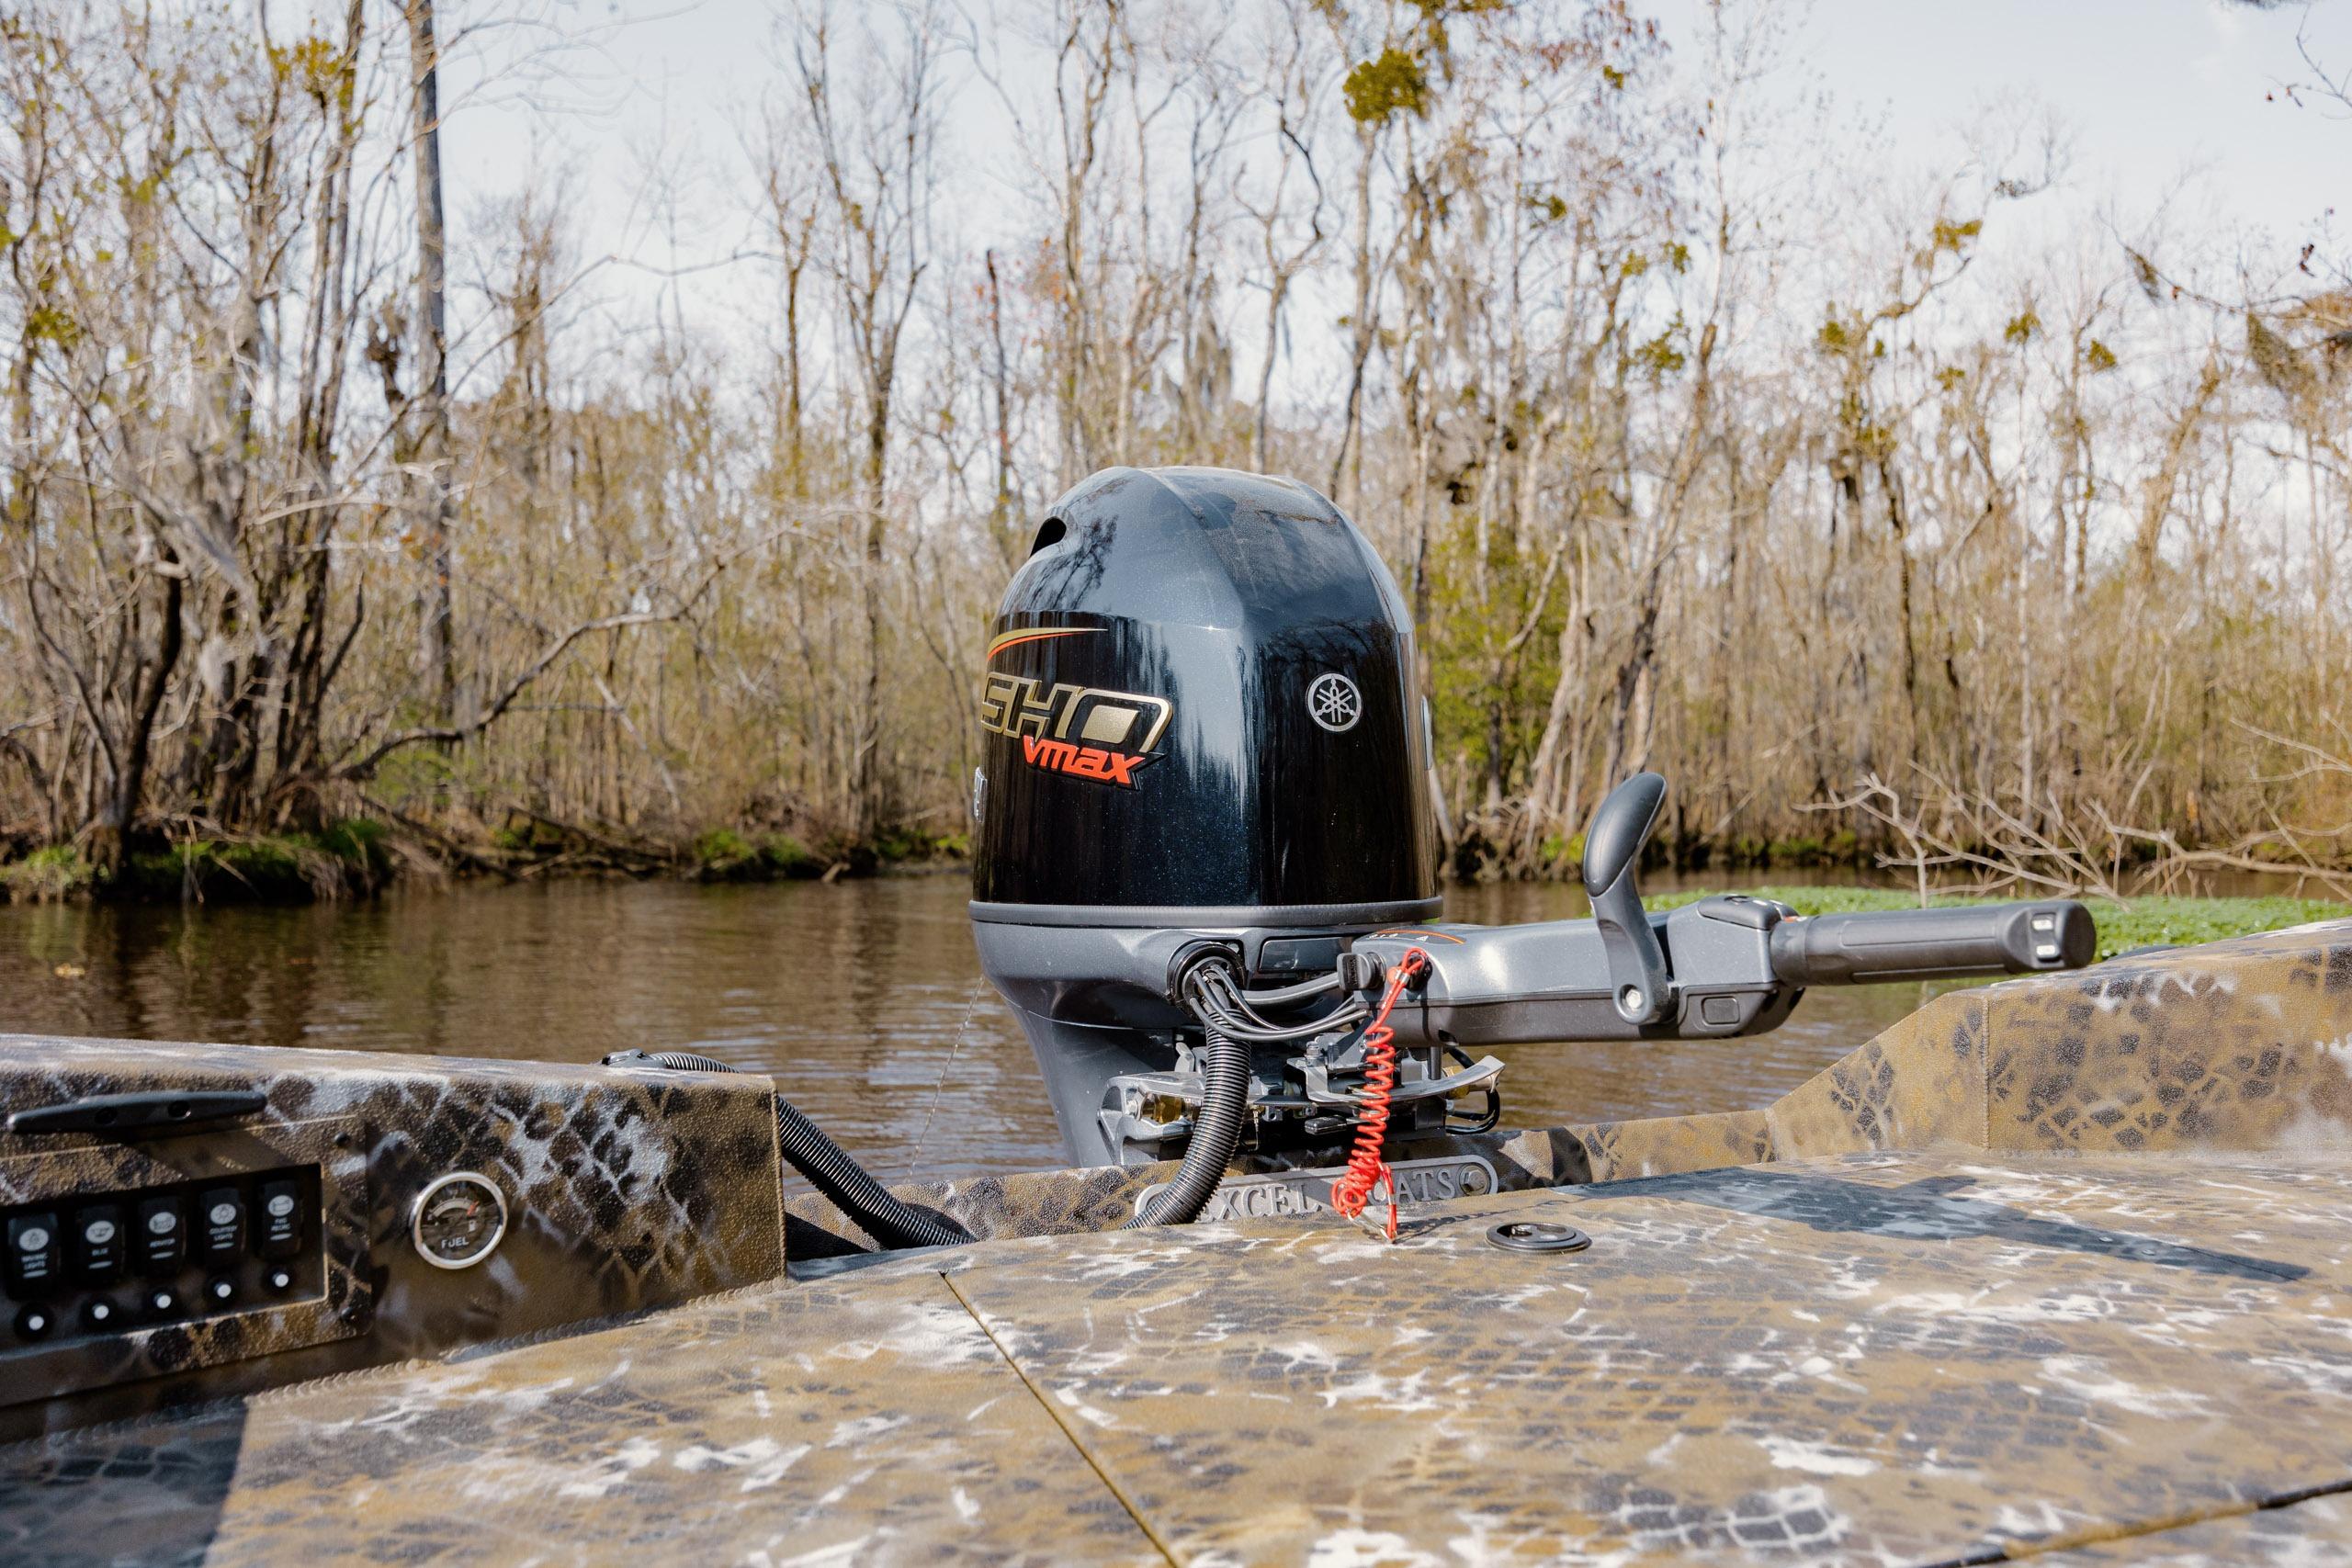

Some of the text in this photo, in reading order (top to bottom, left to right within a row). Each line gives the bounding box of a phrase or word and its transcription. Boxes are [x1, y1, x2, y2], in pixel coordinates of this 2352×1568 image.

[980, 671, 1173, 753] SHO
[1366, 1168, 1455, 1206] OATS
[441, 1235, 469, 1249] FUEL
